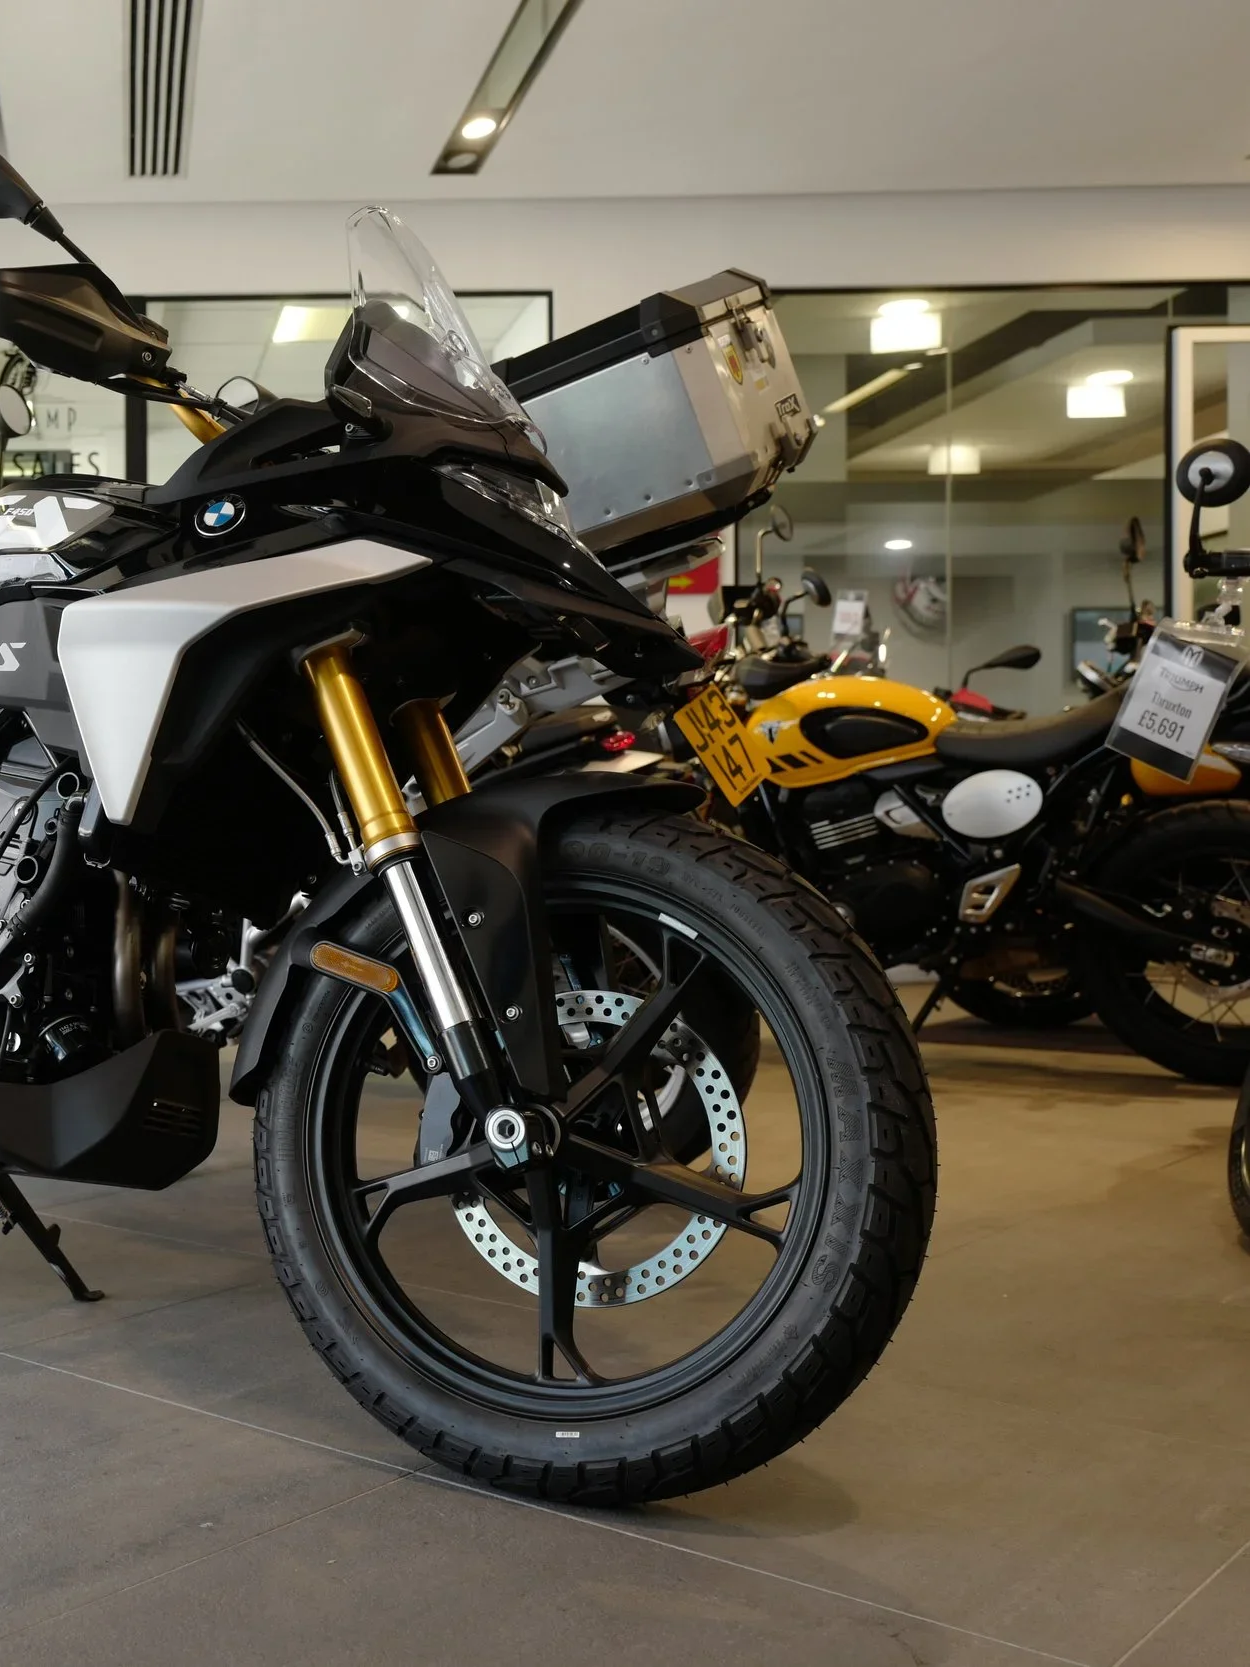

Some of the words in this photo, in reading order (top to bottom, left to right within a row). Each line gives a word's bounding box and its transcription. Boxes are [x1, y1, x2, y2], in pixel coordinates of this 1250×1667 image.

[13, 451, 100, 479] SALES
[3, 507, 34, 516] F450
[1159, 667, 1204, 694] TRIUMPH
[1151, 691, 1193, 719] Thruxton
[1137, 709, 1185, 743] £5,691
[712, 733, 756, 791] 147
[810, 1055, 865, 1293] MAXXIS
